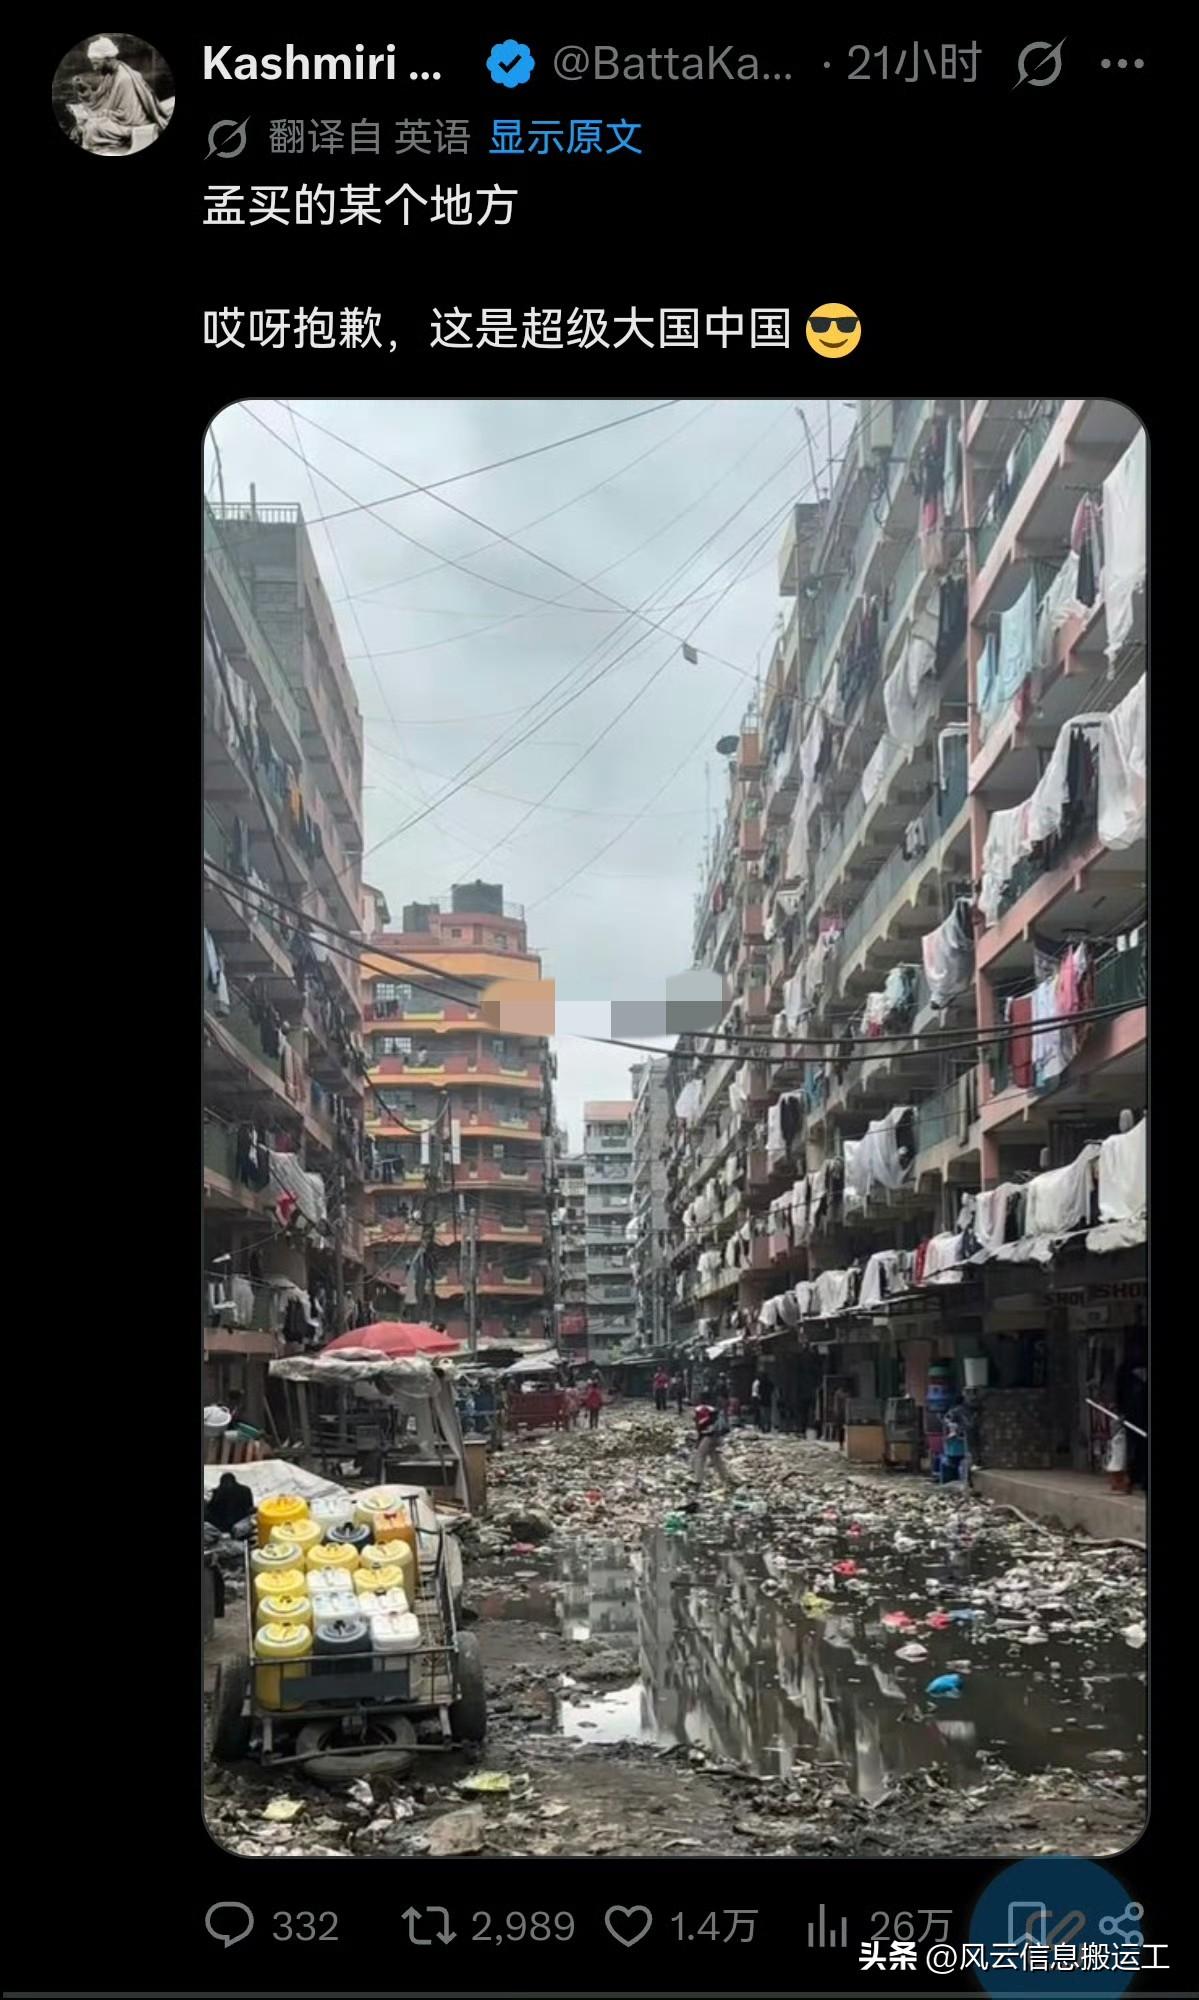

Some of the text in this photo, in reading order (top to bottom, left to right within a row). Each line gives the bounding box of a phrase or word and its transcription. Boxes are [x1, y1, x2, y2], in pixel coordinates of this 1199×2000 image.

[203, 43, 396, 81] Kashmiri
[553, 45, 793, 82] @BattaKa...
[847, 40, 983, 83] 21小时
[269, 117, 471, 155] 翻译自 英语
[488, 117, 643, 156] 显示原文
[202, 182, 519, 227] 孟买的某个地方
[203, 305, 790, 353] 哎呀抱歉，这是超级大国中国
[272, 1911, 339, 1941] 332
[471, 1911, 575, 1946] 2,989
[671, 1909, 759, 1943] 1.4万
[870, 1909, 953, 1943] 26万
